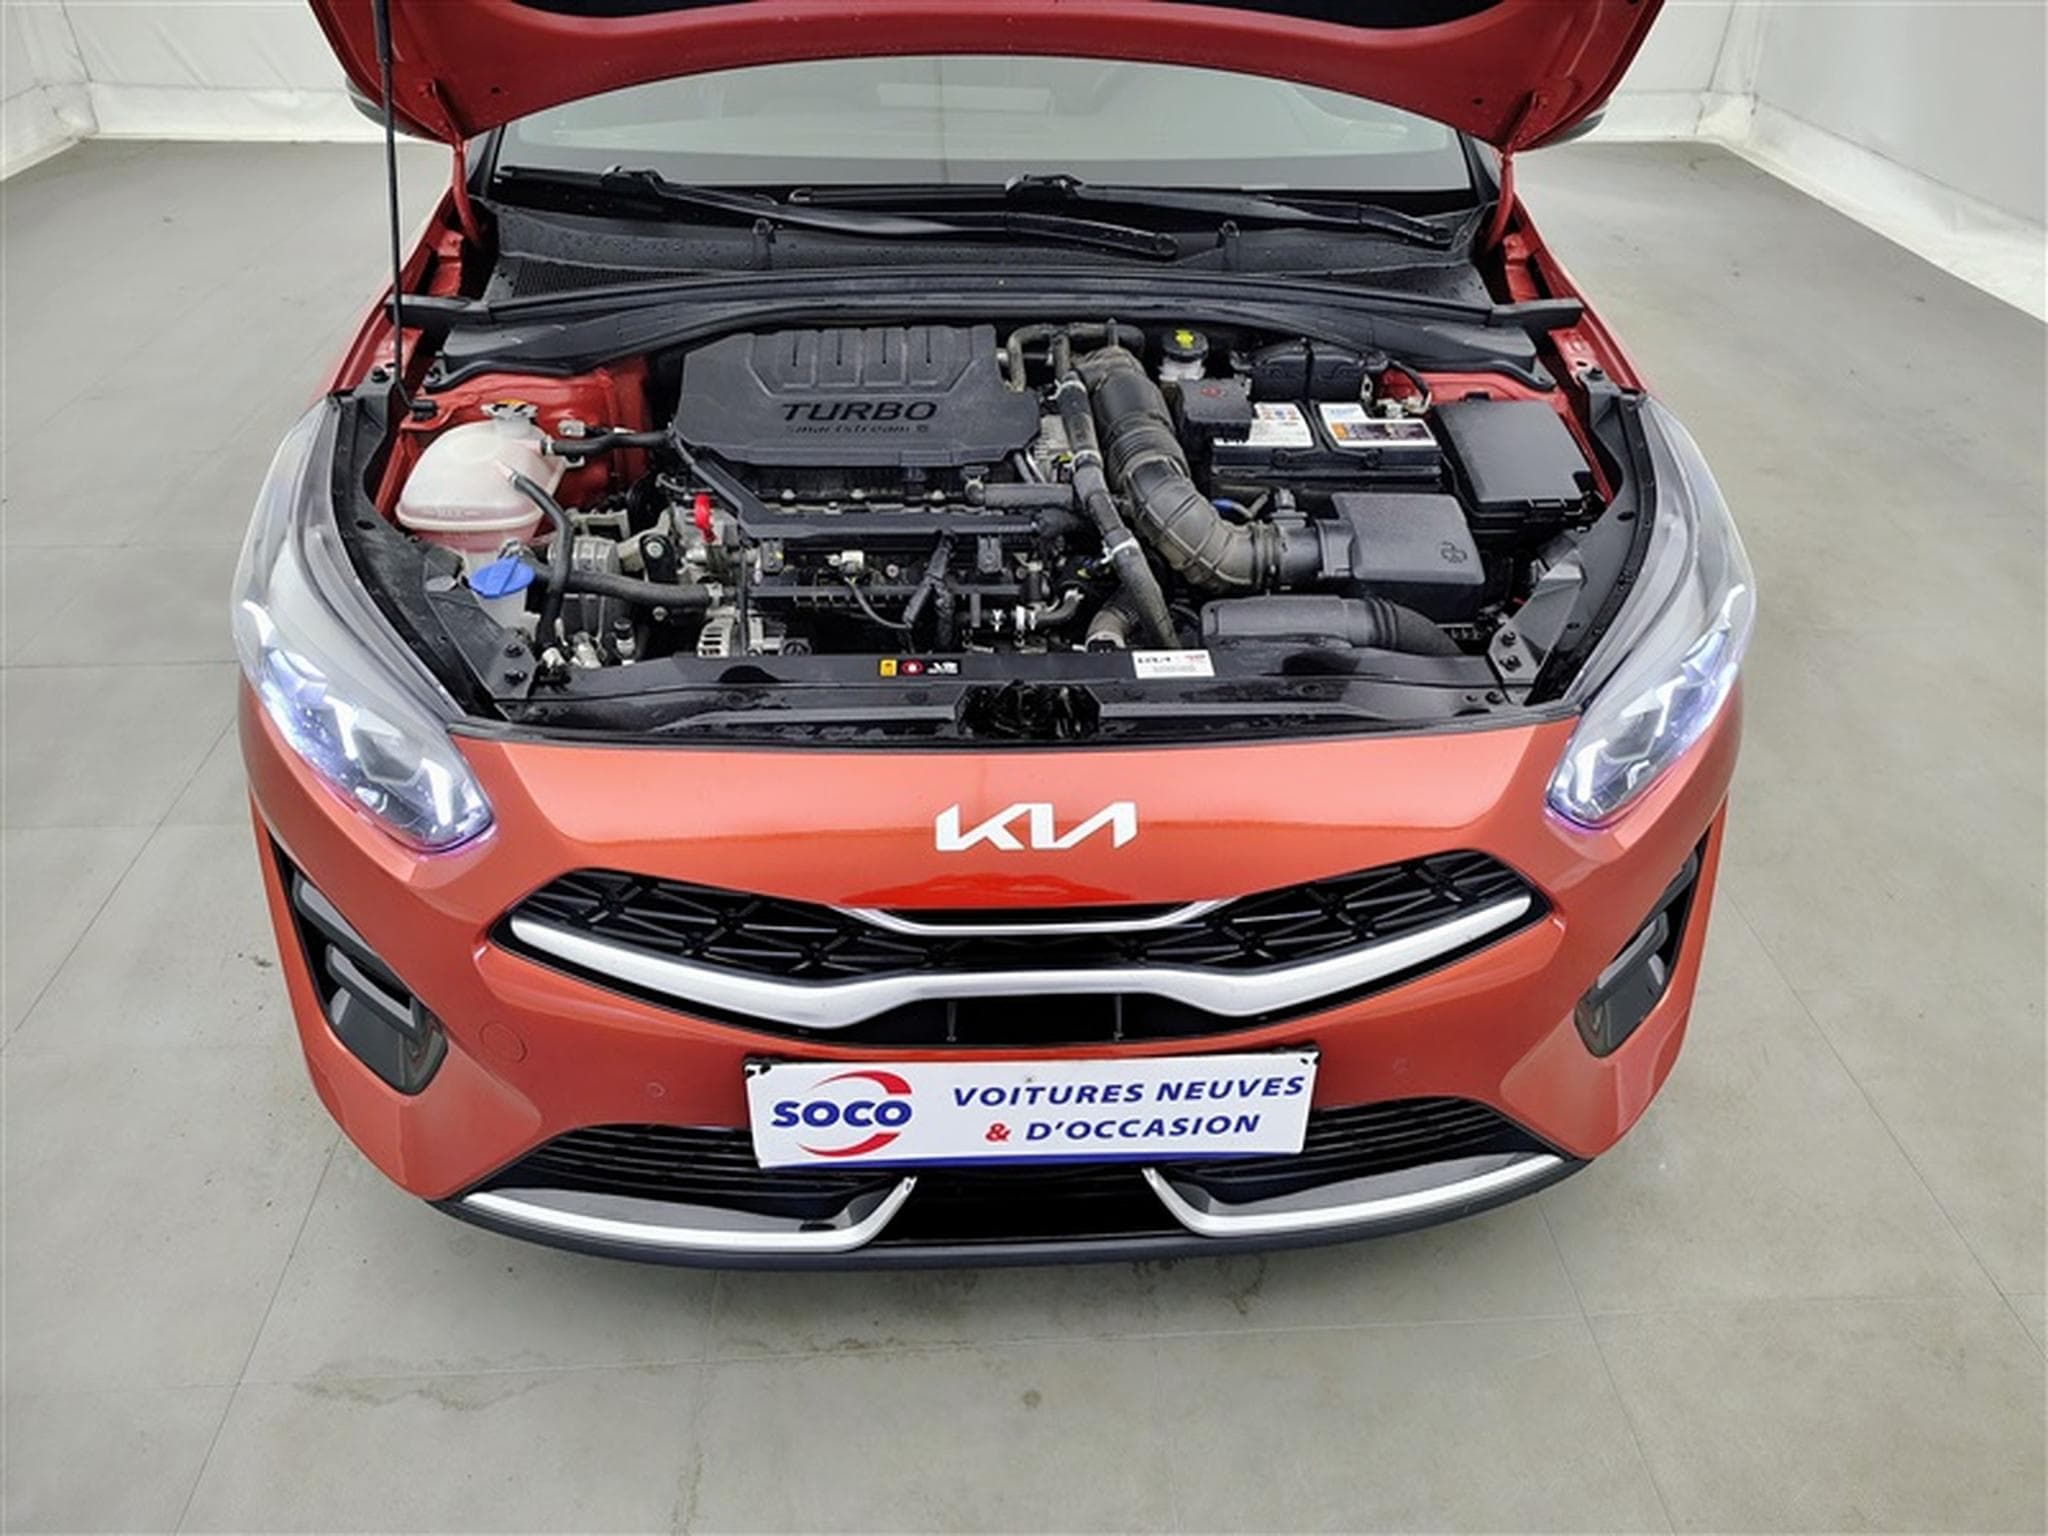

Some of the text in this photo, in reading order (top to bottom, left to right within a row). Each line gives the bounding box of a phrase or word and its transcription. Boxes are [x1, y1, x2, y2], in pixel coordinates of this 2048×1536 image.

[781, 401, 938, 421] TURBO
[935, 802, 1137, 852] KIA
[953, 1075, 1304, 1106] VOITURES NEUVES
[772, 1100, 913, 1127] SOCO
[984, 1114, 1260, 1142] & D'OCCASION
